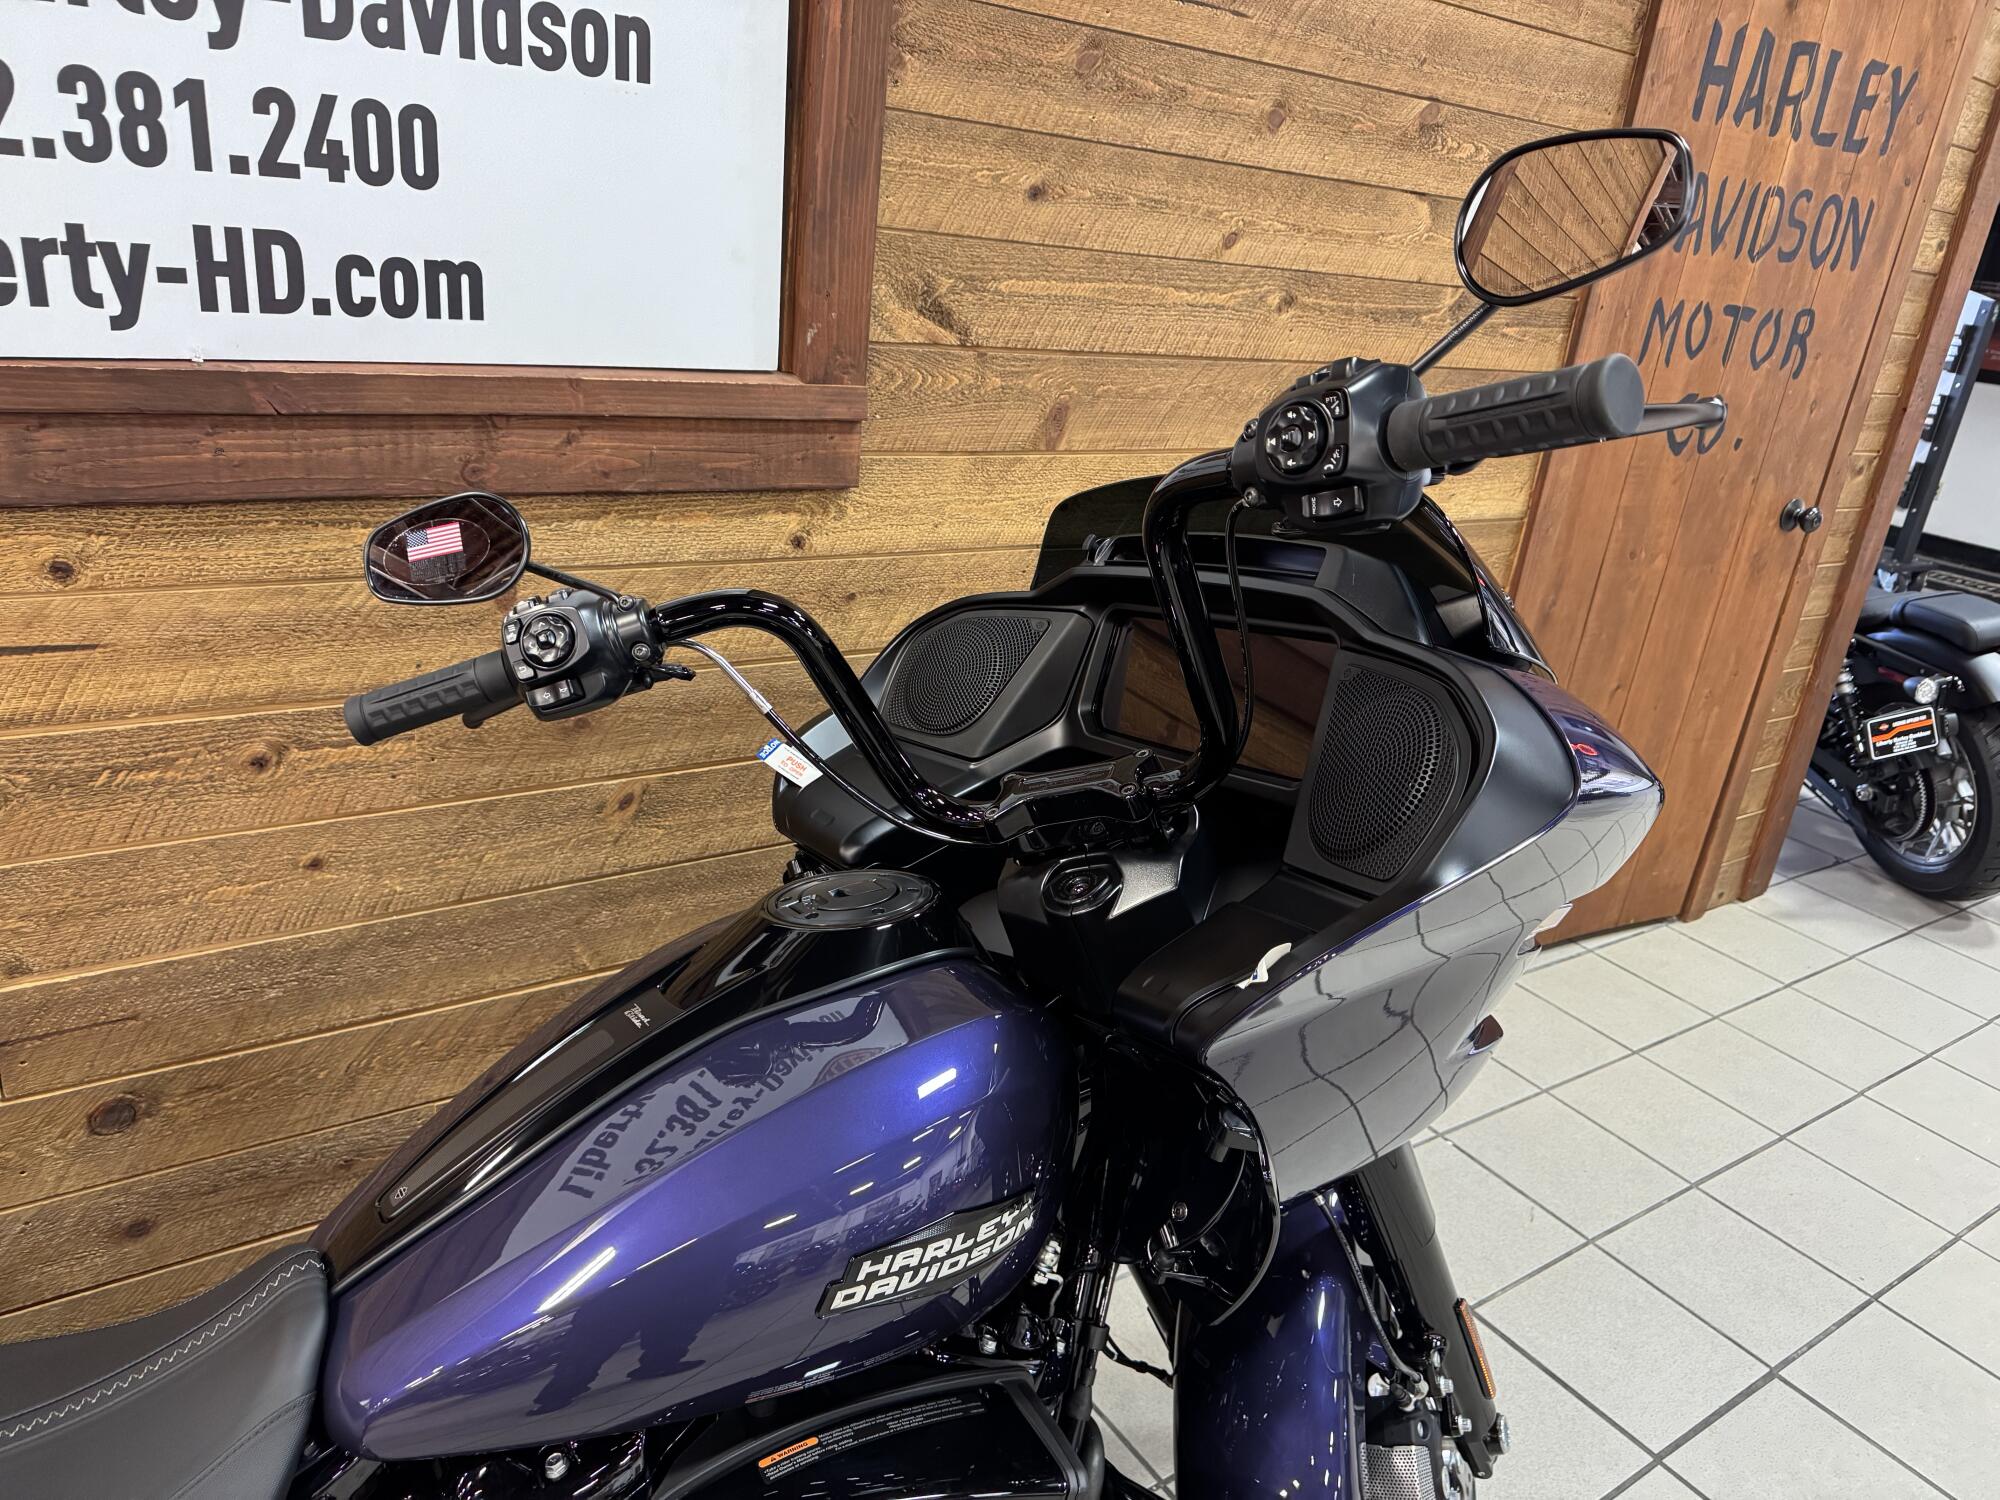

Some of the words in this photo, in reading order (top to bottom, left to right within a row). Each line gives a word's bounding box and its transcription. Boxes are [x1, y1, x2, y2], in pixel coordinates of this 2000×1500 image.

[1692, 17, 1919, 157] HARLEY
[1673, 171, 1875, 273] AVIDSON
[1638, 296, 1816, 380] MOTOR
[786, 756, 808, 772] PUSH
[829, 1211, 1034, 1310] DAVIDSON
[776, 1441, 809, 1458] WARNING
